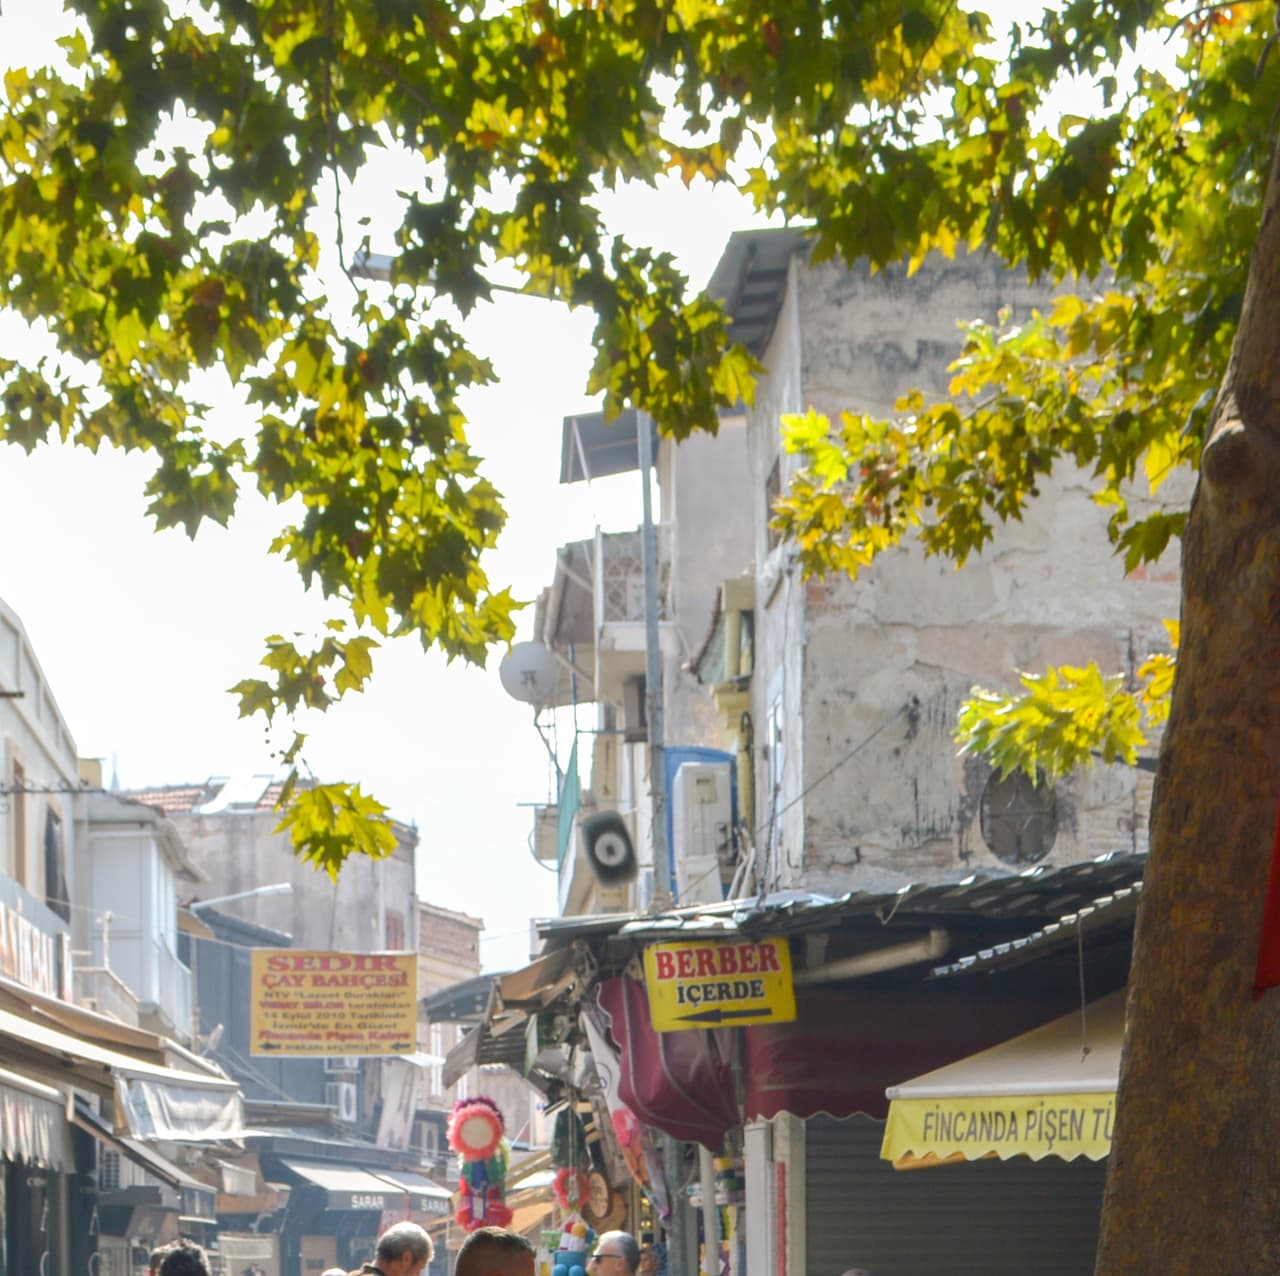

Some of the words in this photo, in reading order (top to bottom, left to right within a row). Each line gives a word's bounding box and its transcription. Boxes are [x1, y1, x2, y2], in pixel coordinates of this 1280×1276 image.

[655, 943, 781, 980] BERBER
[261, 974, 305, 989] ÇAY
[677, 980, 765, 1007] İÇERDE
[923, 1104, 1019, 1143] FİNCANDA
[1024, 1101, 1086, 1150] PİŞEN
[351, 1194, 384, 1209] SARAR
